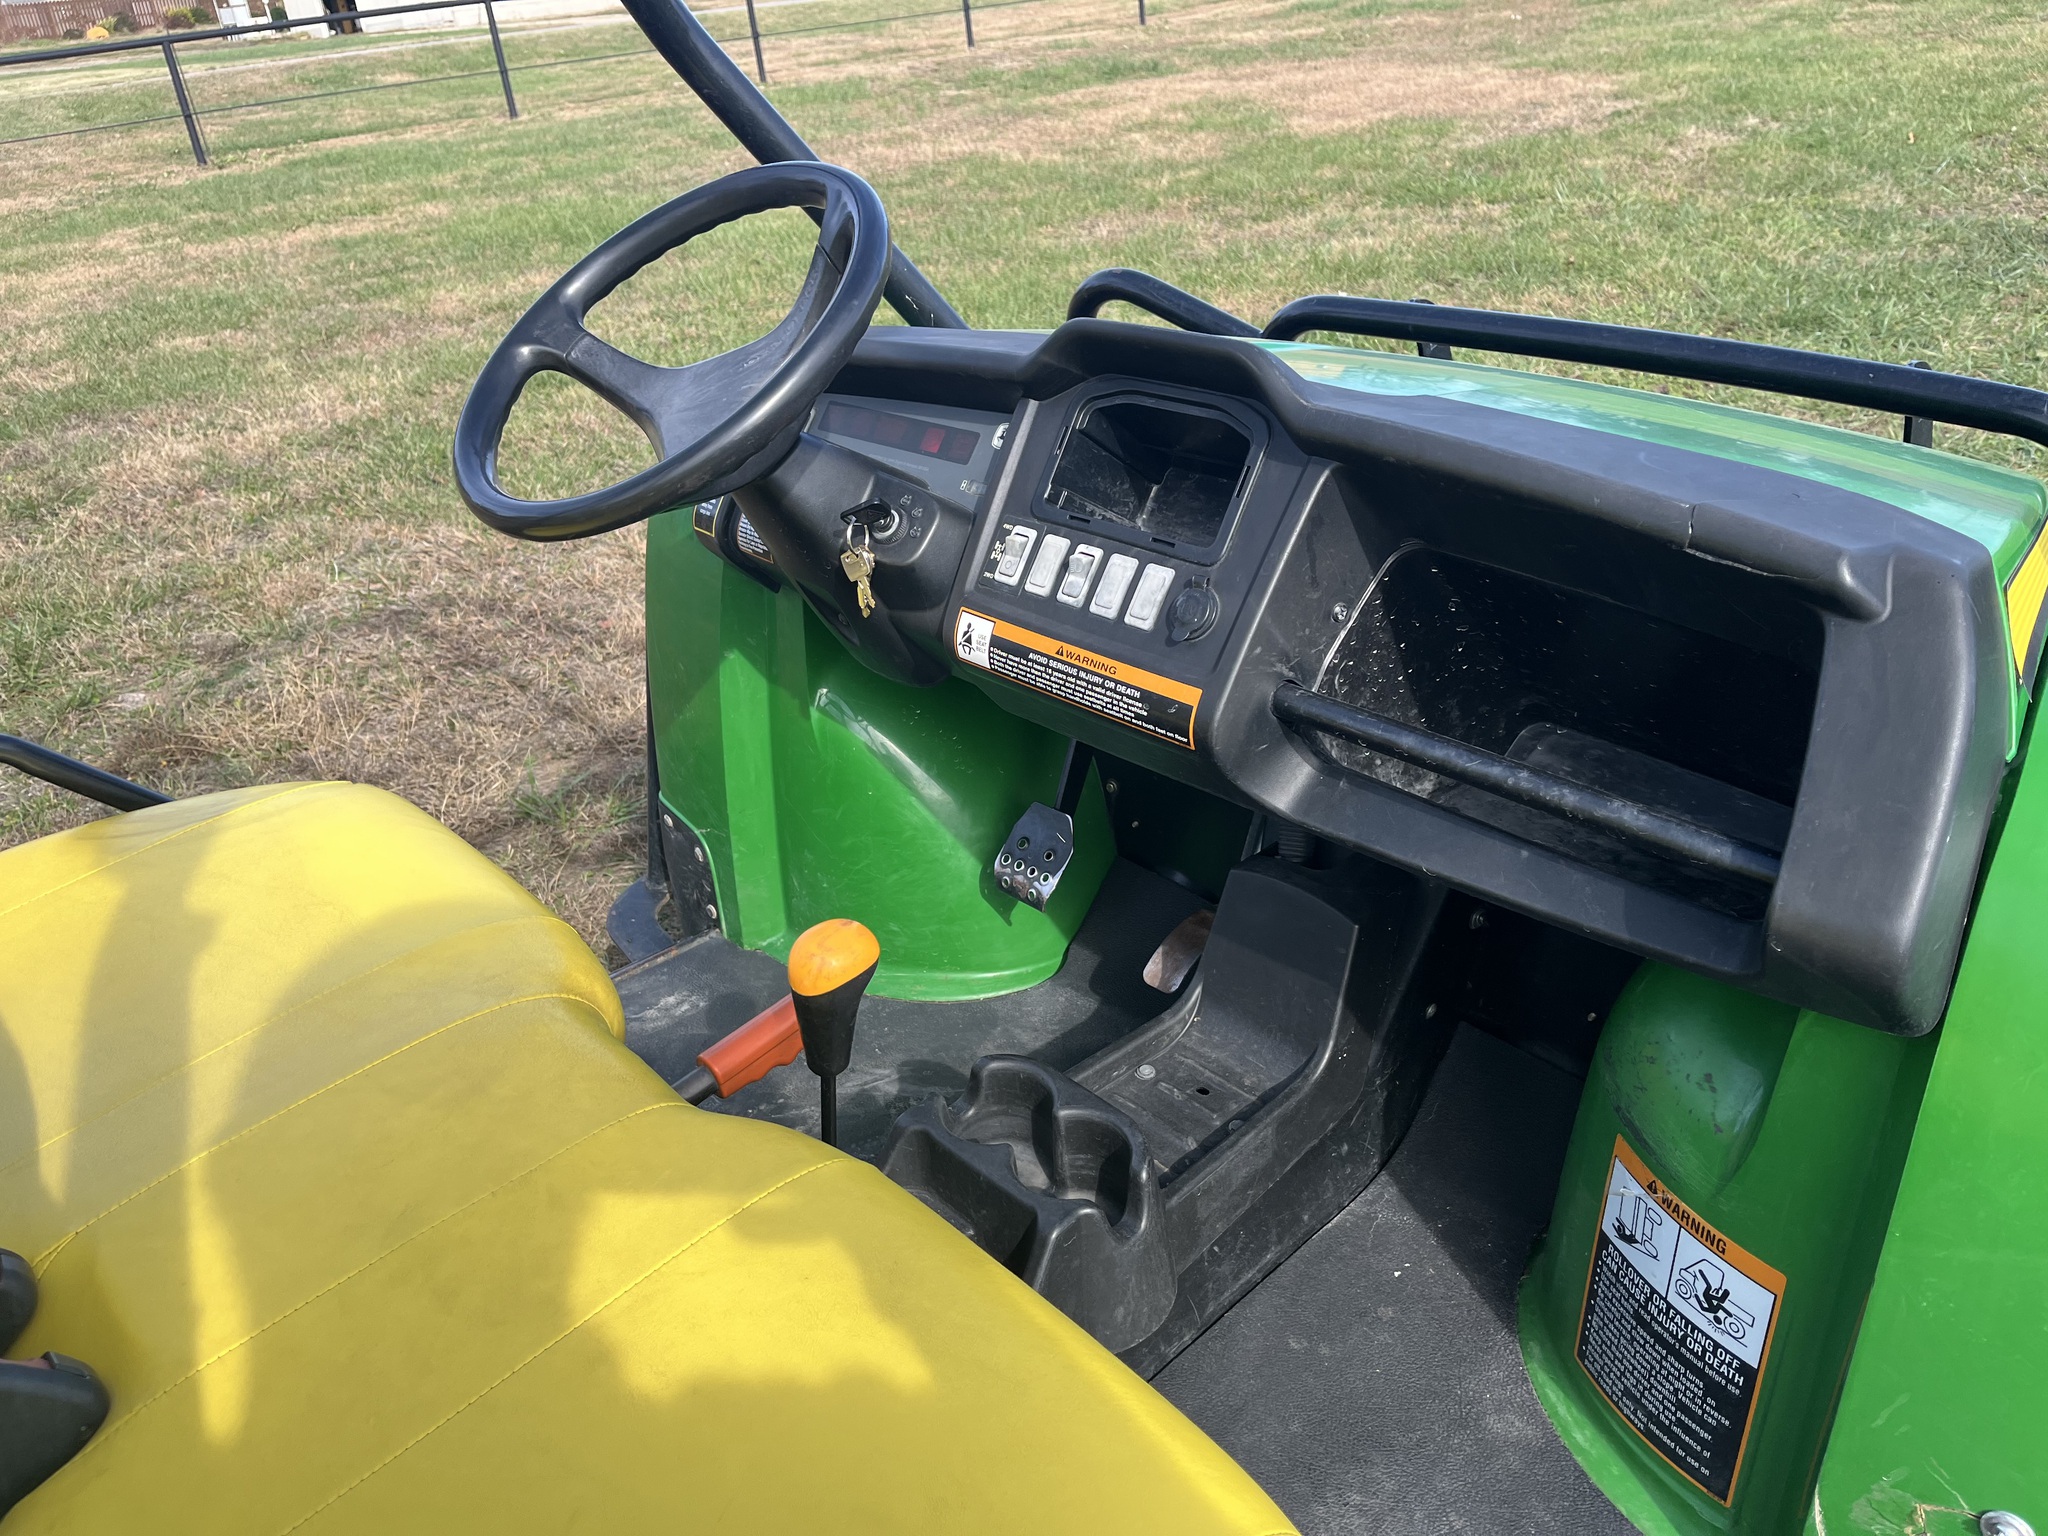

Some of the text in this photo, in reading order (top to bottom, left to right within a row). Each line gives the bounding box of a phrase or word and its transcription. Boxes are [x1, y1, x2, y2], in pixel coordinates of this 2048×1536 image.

[1003, 523, 1014, 531] 4WD
[1028, 652, 1047, 664] AVOID
[1048, 659, 1077, 675] SERIOUS
[1078, 670, 1103, 684] INJURY
[1116, 684, 1140, 698] DEATH
[1066, 649, 1116, 674] WARNING
[1036, 676, 1059, 688] passenger
[1085, 689, 1111, 702] passenger
[1128, 705, 1147, 715] vehicle
[1105, 690, 1121, 699] driver
[1122, 696, 1142, 707] license
[1661, 1189, 1726, 1255] WARNING
[1602, 1250, 1617, 1273] CAN
[1619, 1270, 1646, 1305] CAUSE
[1647, 1301, 1684, 1338] INJURY
[1686, 1337, 1701, 1355] OR
[1705, 1351, 1743, 1385] DEATH
[1608, 1244, 1650, 1296] ROLLOVER
[1669, 1308, 1713, 1353] FALLING
[1716, 1348, 1740, 1368] OFF
[1633, 1341, 1659, 1370] operating
[1668, 1375, 1684, 1391] night
[1637, 1325, 1653, 1344] speed
[1667, 1354, 1684, 1372] sharp
[1645, 1343, 1660, 1360] down
[1662, 1359, 1678, 1377] when
[1651, 1320, 1679, 1348] operator's
[1680, 1347, 1703, 1368] manual
[1704, 1365, 1725, 1385] before
[1633, 1370, 1650, 1388] driver
[1635, 1349, 1650, 1370] down
[1678, 1391, 1702, 1415] Vehicle
[1621, 1375, 1640, 1398] vehicle
[1641, 1397, 1658, 1415] under
[1670, 1423, 1700, 1451] influence
[1644, 1390, 1663, 1411] during
[1648, 1421, 1674, 1448] intended
